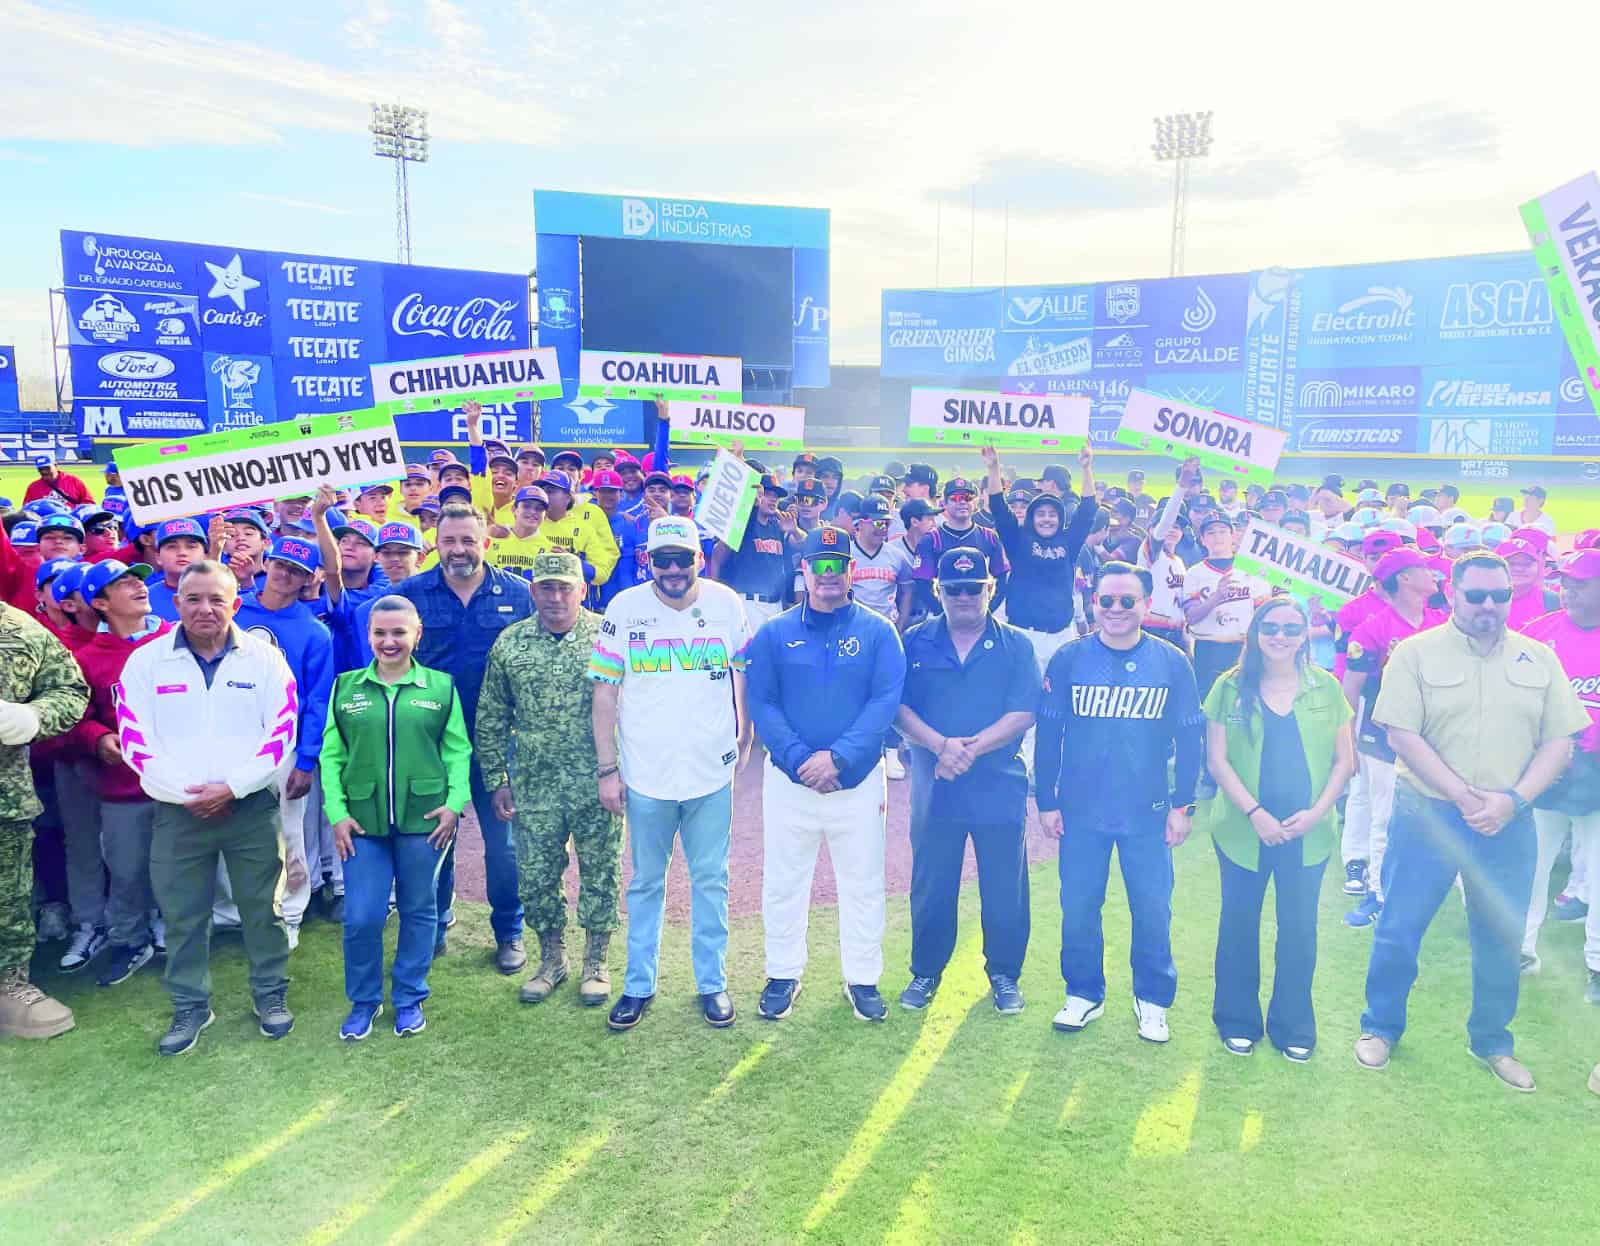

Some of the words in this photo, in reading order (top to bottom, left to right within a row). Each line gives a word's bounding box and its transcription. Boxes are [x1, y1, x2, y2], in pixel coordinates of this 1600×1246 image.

[661, 203, 709, 218] BEDA
[662, 221, 752, 239] INDUSTRIAS
[104, 259, 175, 274] AVANZADA
[281, 261, 358, 287] TECATE
[203, 307, 242, 326] Carl's
[286, 298, 362, 323] TECATE
[392, 292, 520, 341] Coca-Cola
[1312, 309, 1416, 332] Electrolit
[288, 336, 363, 359] TECATE
[1155, 337, 1201, 348] GRUPO
[115, 354, 157, 374] Ford
[944, 346, 996, 363] GIMSA
[1155, 347, 1240, 364] LAZALDE
[389, 358, 544, 395] CHIHUAHUA
[601, 360, 721, 387] COAHUILA
[1257, 333, 1280, 423] DEPORTE
[99, 380, 178, 391] AUTOMOTRIZ
[114, 388, 179, 399] MONCLOVA
[291, 375, 366, 397] TECATE
[1098, 379, 1129, 397] 146
[1343, 383, 1416, 398] MIKARO
[128, 416, 207, 430] MONCLOVA
[224, 410, 264, 426] Little
[690, 406, 776, 432] JALISCO
[943, 399, 1056, 429] SINALOA
[560, 426, 587, 437] Grupo
[588, 425, 625, 436] Industrial
[1153, 407, 1253, 457] SONORA
[340, 437, 397, 471] BAJA
[188, 448, 331, 497] CALIFORNIA
[128, 480, 183, 507] SUR
[704, 461, 744, 534] NUEVO
[630, 632, 646, 640] DE
[629, 638, 728, 672] MVA
[710, 671, 727, 680] SOY
